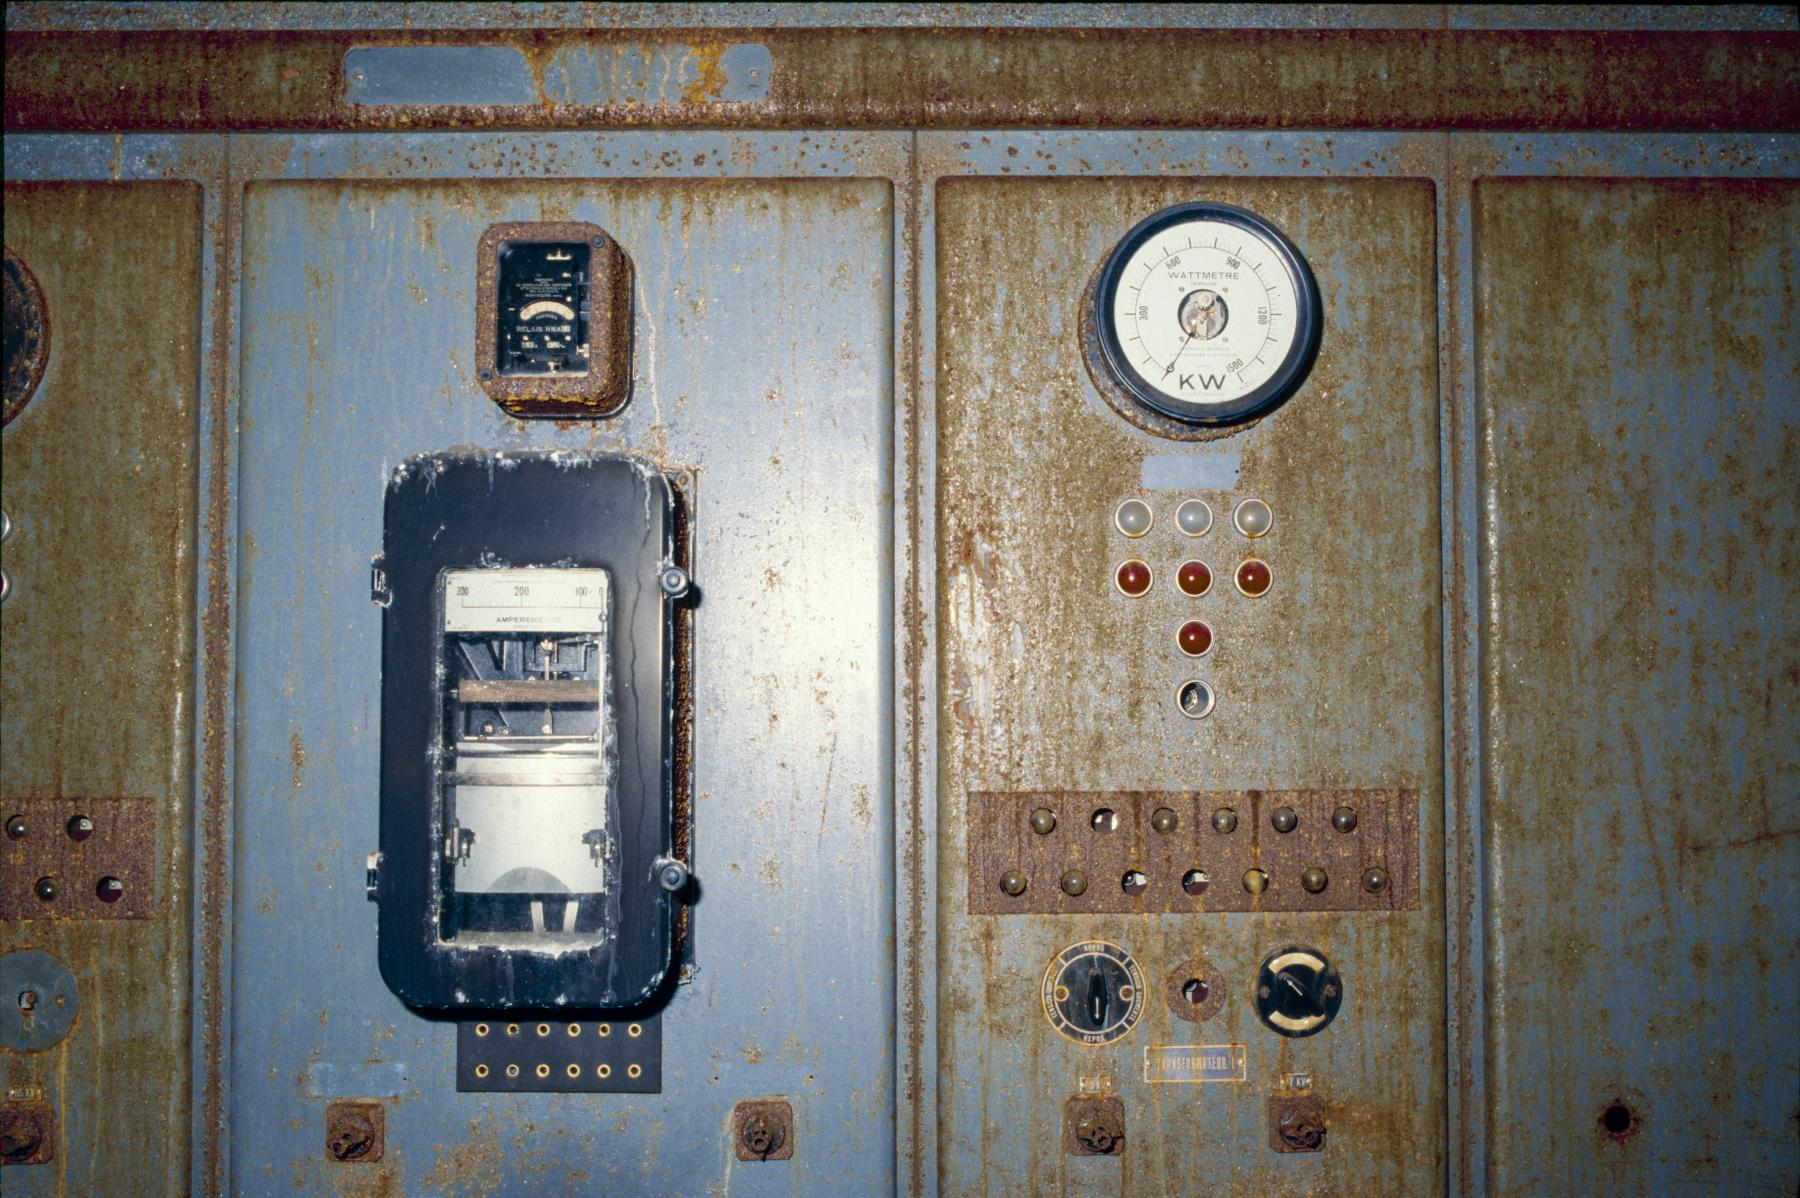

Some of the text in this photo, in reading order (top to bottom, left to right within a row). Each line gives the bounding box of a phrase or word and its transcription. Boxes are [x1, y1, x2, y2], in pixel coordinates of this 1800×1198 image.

[1165, 256, 1181, 270] 600
[1226, 257, 1241, 270] 900
[1168, 271, 1240, 280] WATTMETRE
[1138, 305, 1149, 321] 300
[1257, 306, 1267, 326] 1200
[1226, 358, 1244, 374] 1500
[1179, 374, 1227, 390] KW
[456, 586, 469, 596] 300
[513, 586, 530, 596] 200
[575, 586, 588, 596] 100
[1083, 1034, 1105, 1042] REPOS
